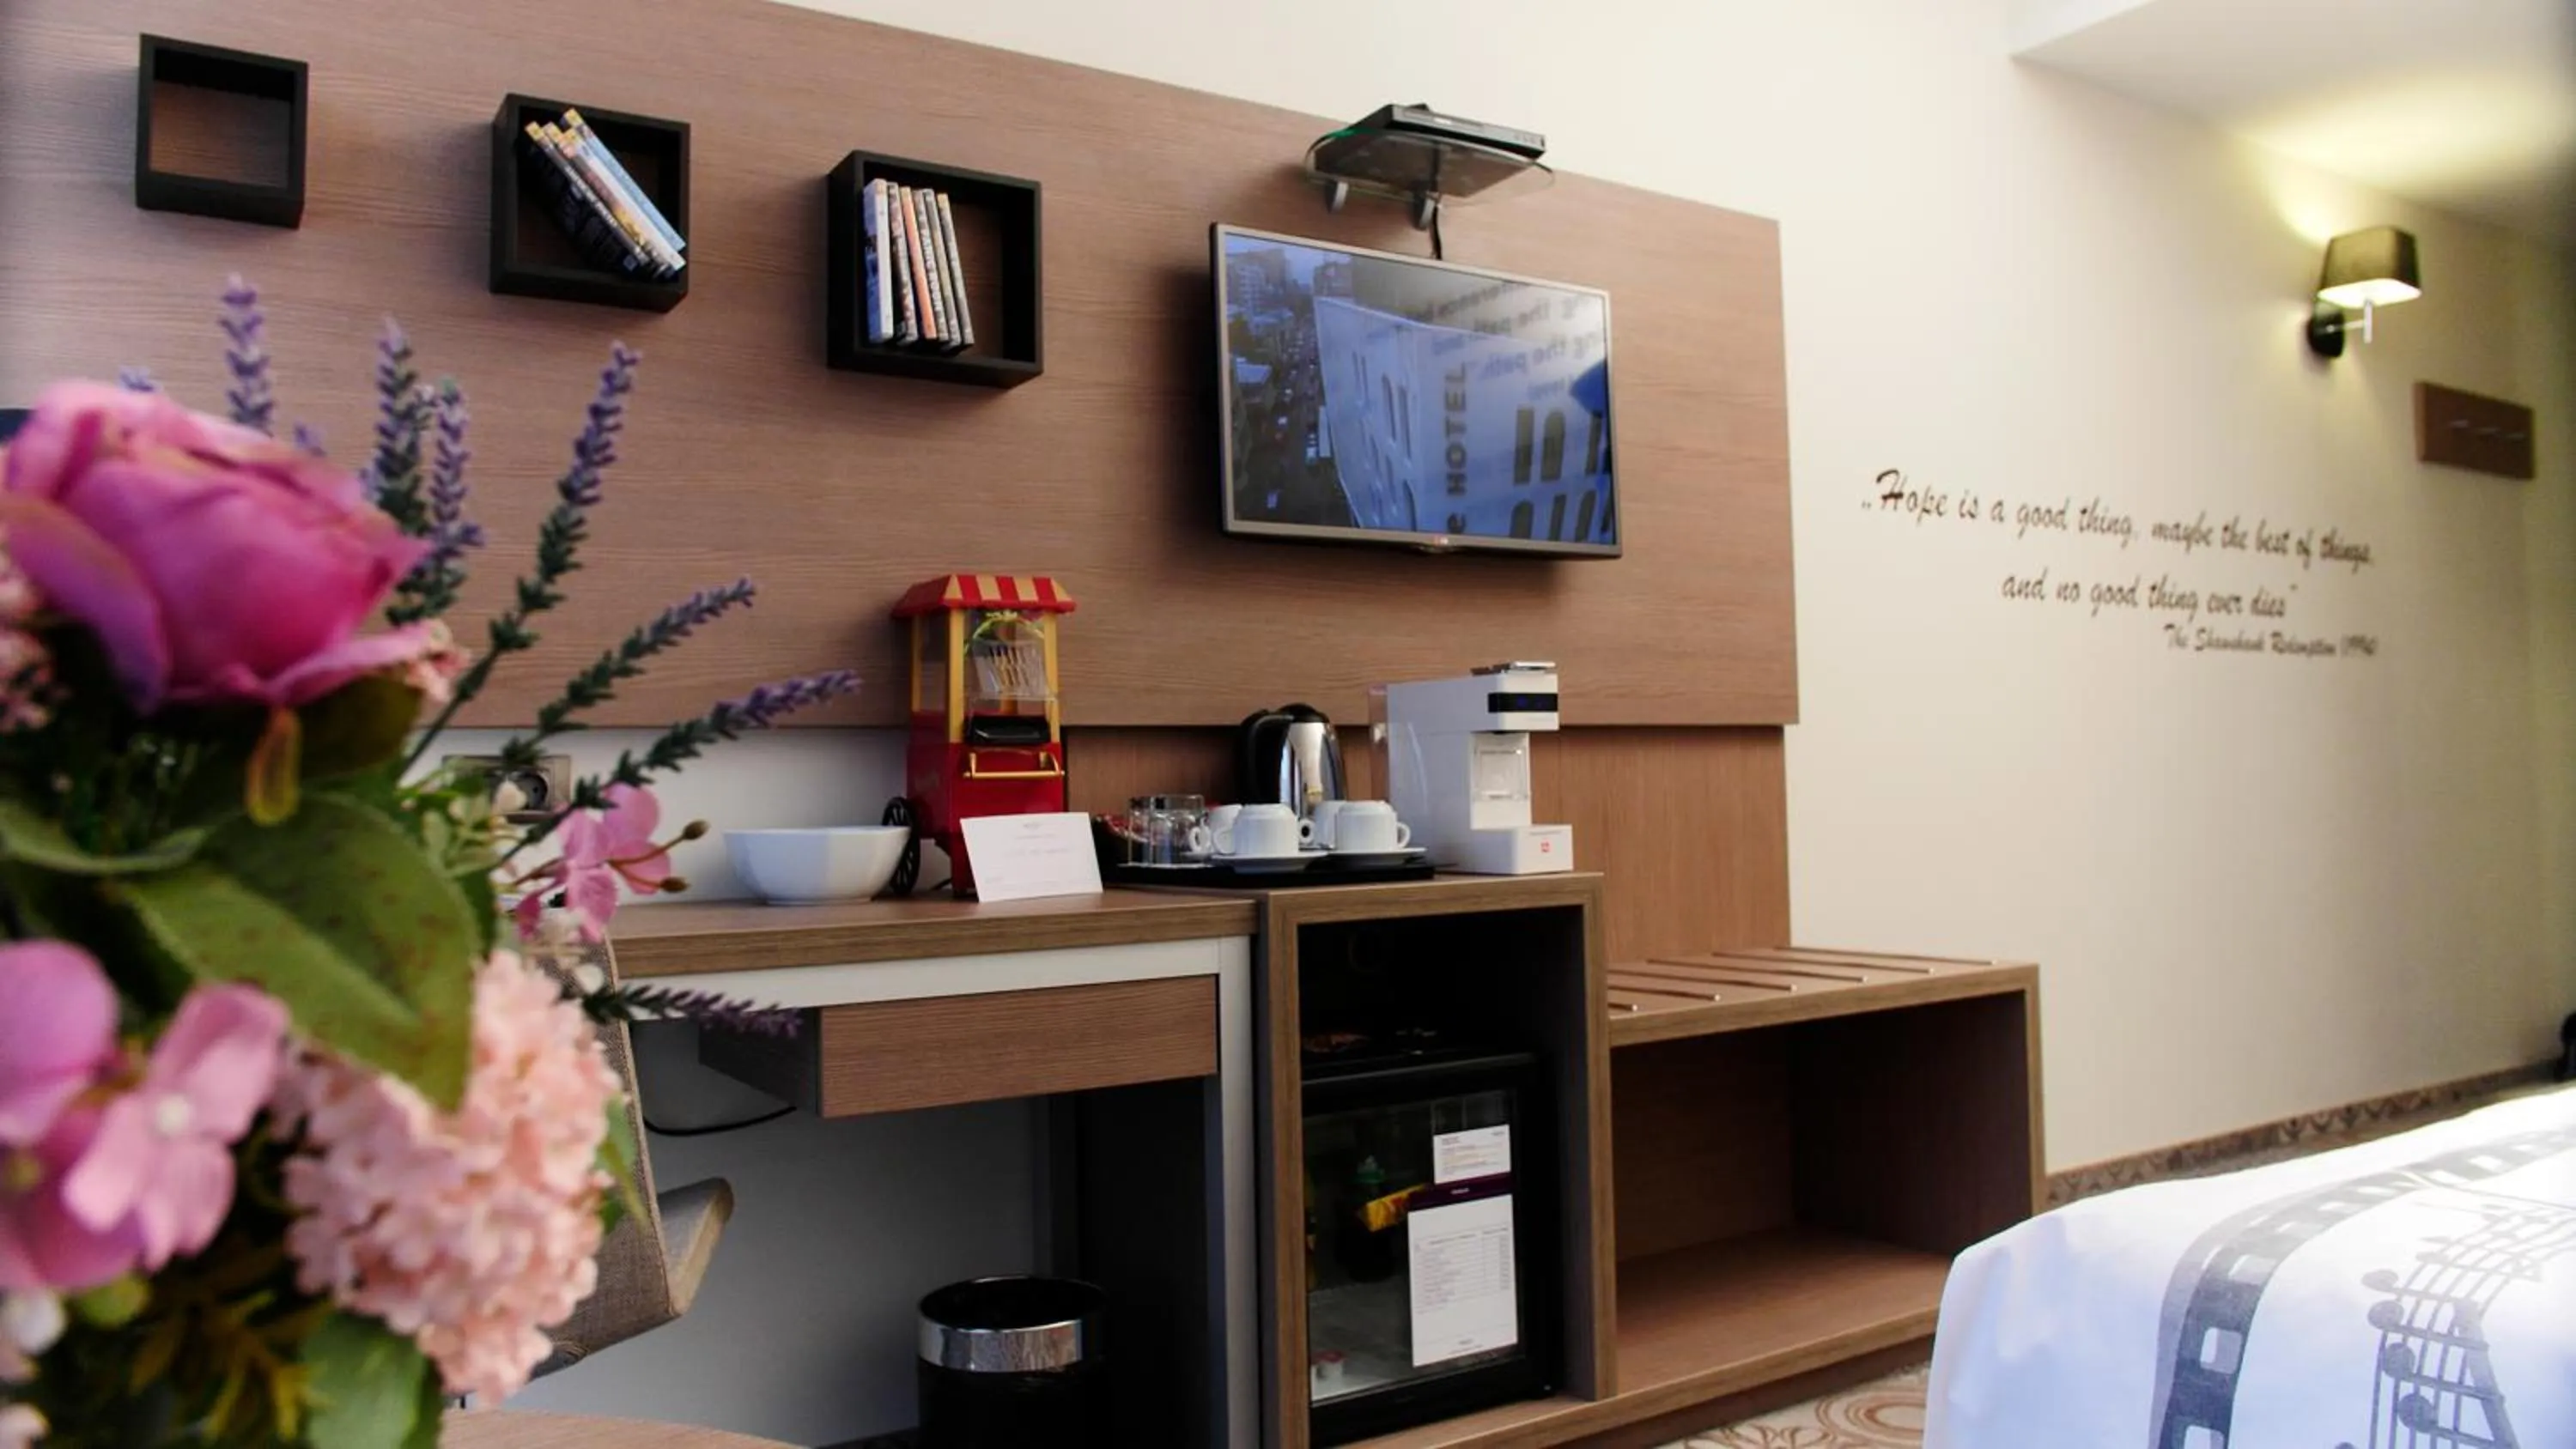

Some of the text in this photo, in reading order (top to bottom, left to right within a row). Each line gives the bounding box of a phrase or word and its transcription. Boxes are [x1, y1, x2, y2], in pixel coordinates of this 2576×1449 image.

[920, 228, 936, 270] PANIC
[1444, 361, 1467, 497] HOTEL
[1959, 489, 1979, 520] is
[1990, 499, 2005, 523] a
[2018, 496, 2069, 539] good
[2152, 510, 2214, 555] maybe
[2221, 515, 2249, 550] the
[2255, 518, 2290, 555] best
[2296, 527, 2314, 570] of
[2002, 566, 2048, 600] and
[2057, 579, 2081, 603] no
[2090, 574, 2138, 617] good
[2148, 573, 2198, 623] thing
[2206, 591, 2243, 615] ever
[2163, 622, 2190, 650] The
